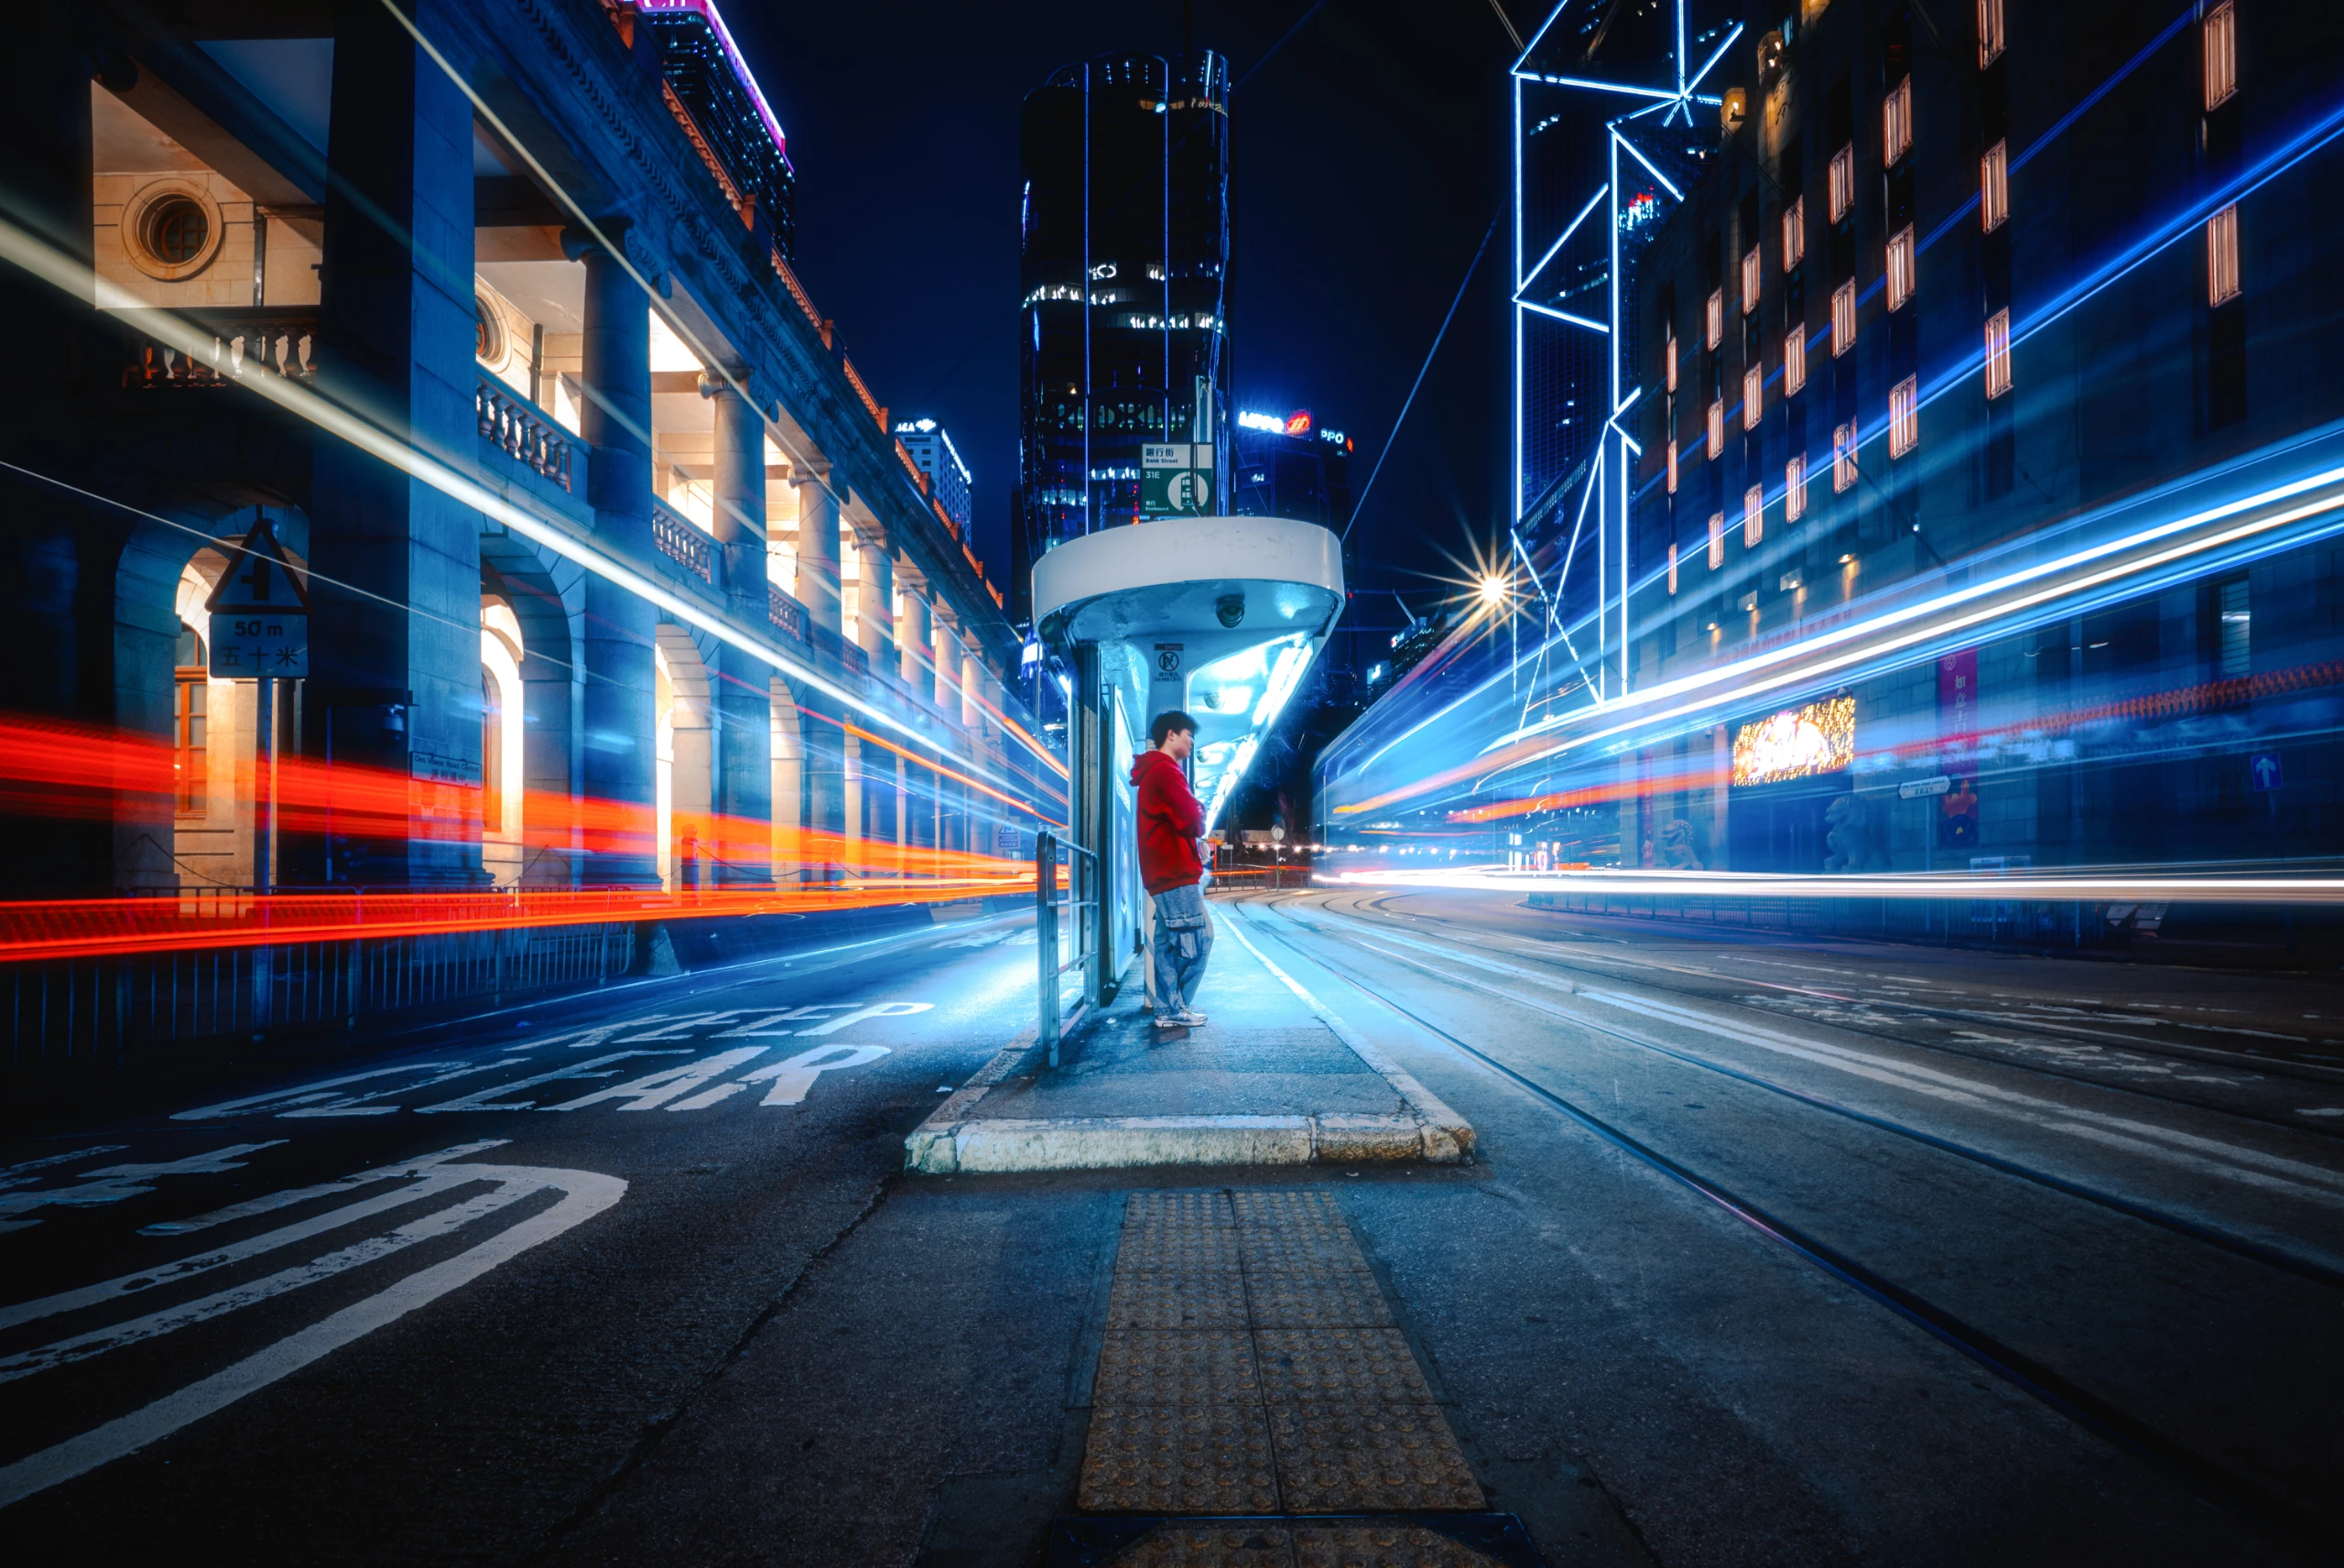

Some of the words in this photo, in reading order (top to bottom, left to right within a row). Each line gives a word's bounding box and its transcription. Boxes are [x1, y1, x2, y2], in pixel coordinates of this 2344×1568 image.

[1145, 448, 1174, 457] 銀行街
[1145, 470, 1160, 479] 31E
[234, 620, 262, 637] 50
[266, 624, 283, 636] m
[221, 645, 298, 668] 五十米
[428, 757, 444, 766] Voeux
[446, 761, 460, 769] Road
[461, 762, 480, 773] Central
[502, 1002, 935, 1051] KEEP
[168, 1044, 892, 1120] CLEAR
